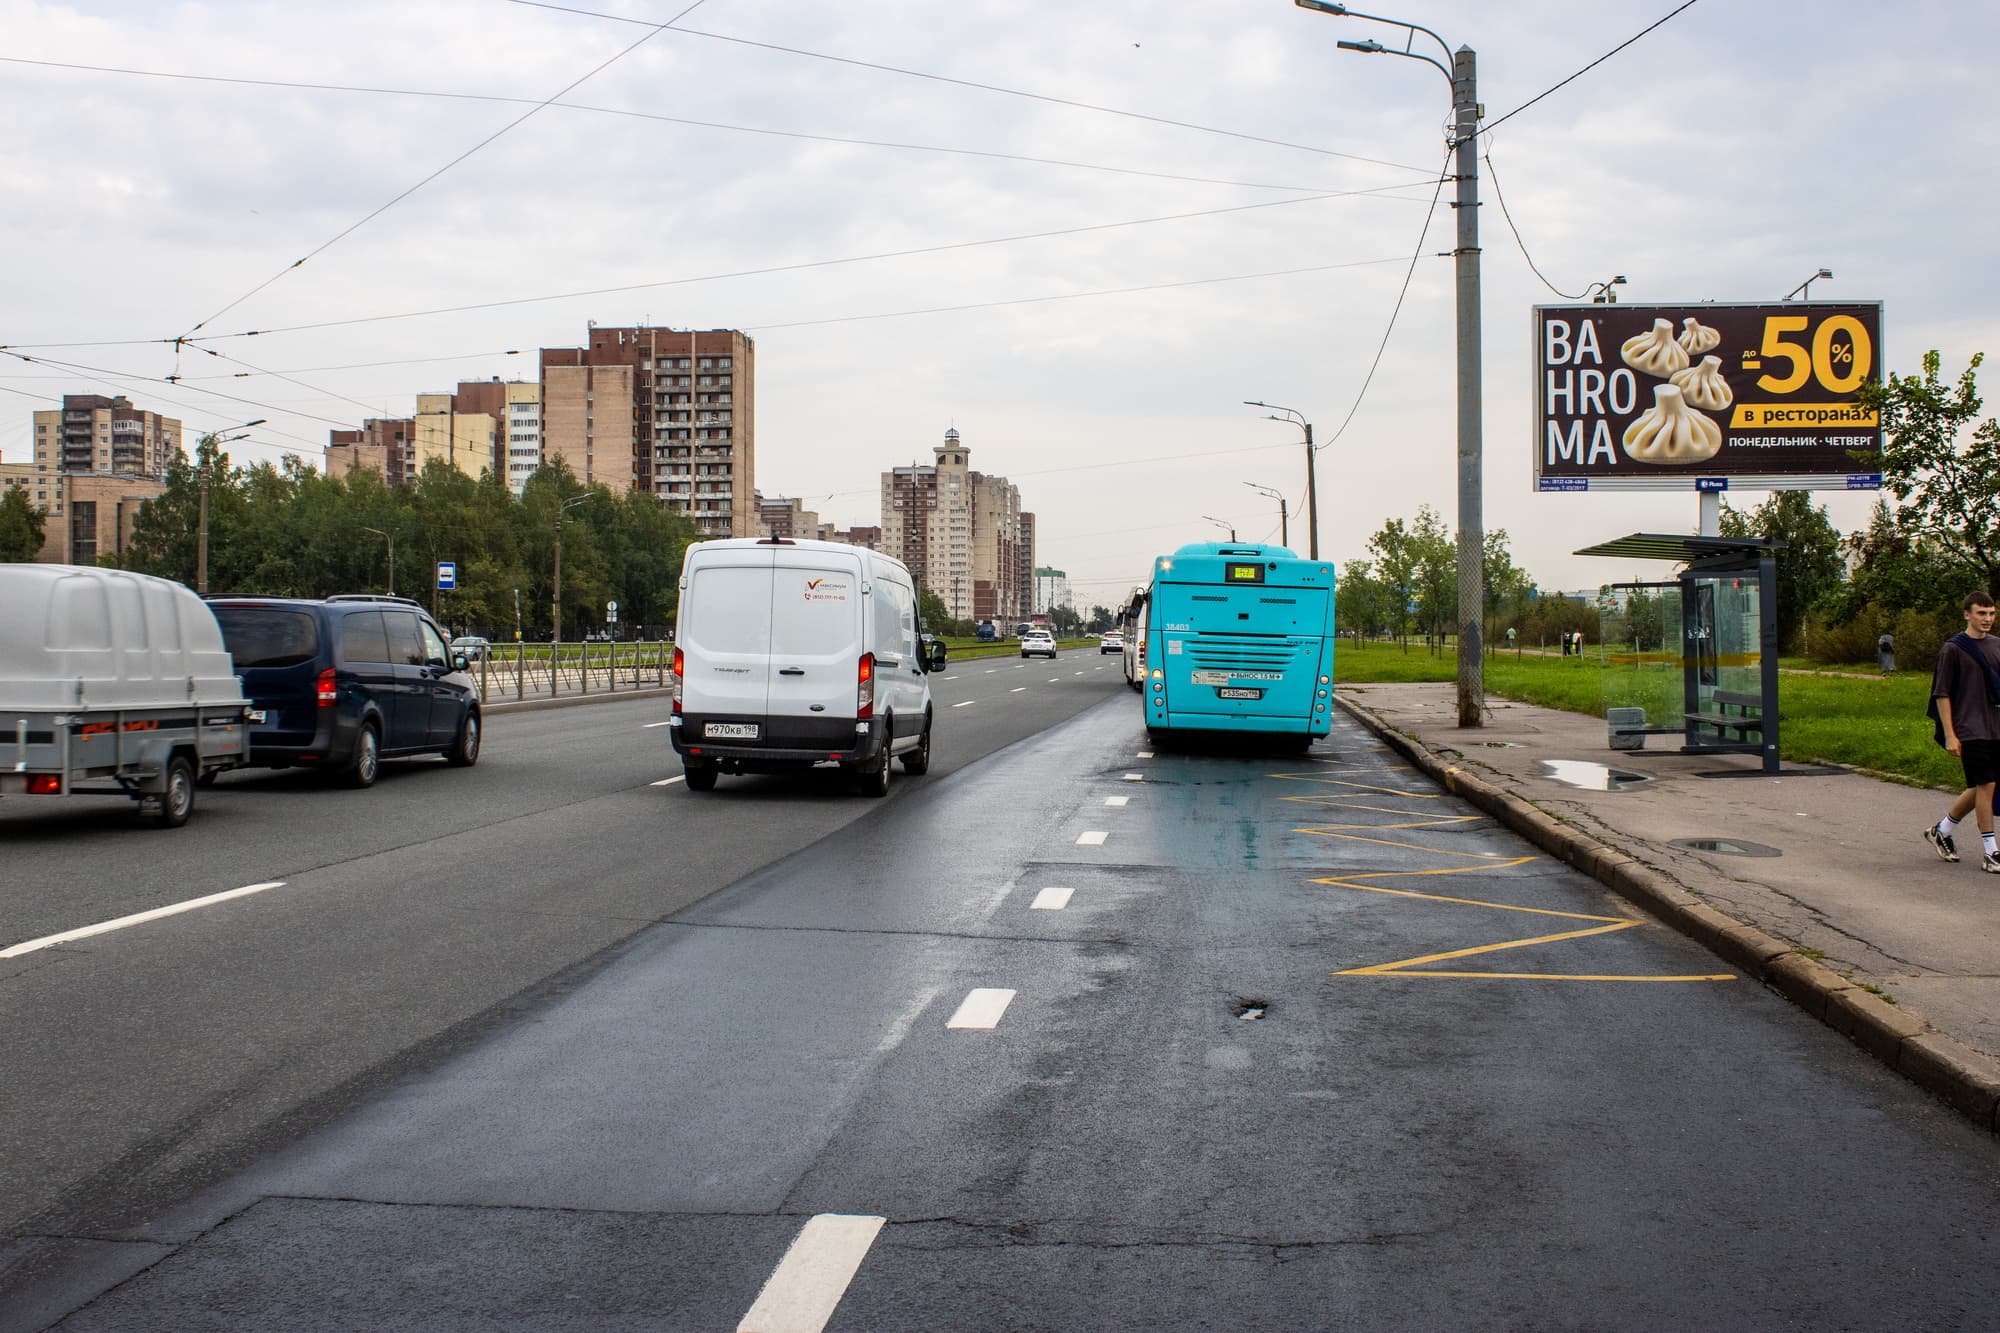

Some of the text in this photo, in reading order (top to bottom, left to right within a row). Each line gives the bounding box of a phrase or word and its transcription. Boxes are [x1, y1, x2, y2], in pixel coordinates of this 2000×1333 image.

[1545, 319, 1602, 365] BA
[1742, 350, 1757, 359] до
[1546, 368, 1637, 415] HRO
[1744, 407, 1873, 425] в ресторанах
[1547, 419, 1618, 465] MA
[1728, 436, 1873, 449] ПОНЕДЕЛЬНИК ЧЕТВЕРГ
